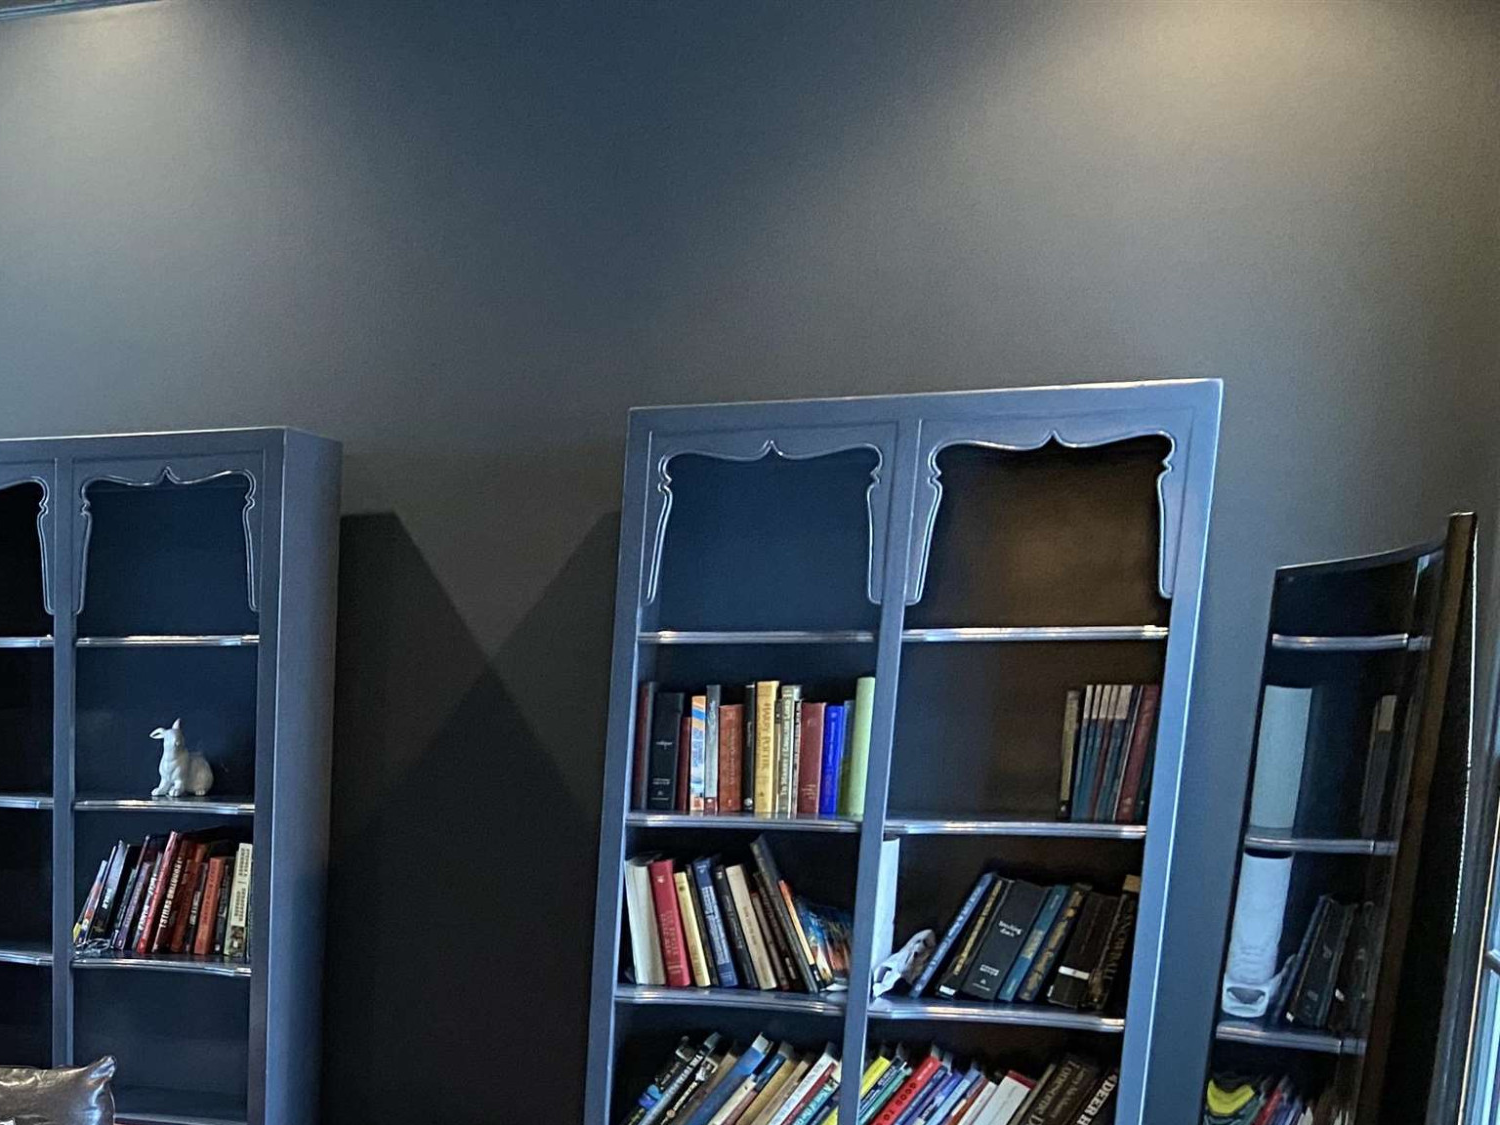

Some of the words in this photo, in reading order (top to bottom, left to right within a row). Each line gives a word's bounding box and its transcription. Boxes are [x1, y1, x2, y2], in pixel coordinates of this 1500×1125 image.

[894, 1081, 918, 1108] GOOD
[1034, 1060, 1081, 1117] Lonesome
[1084, 1079, 1115, 1117] DEER
